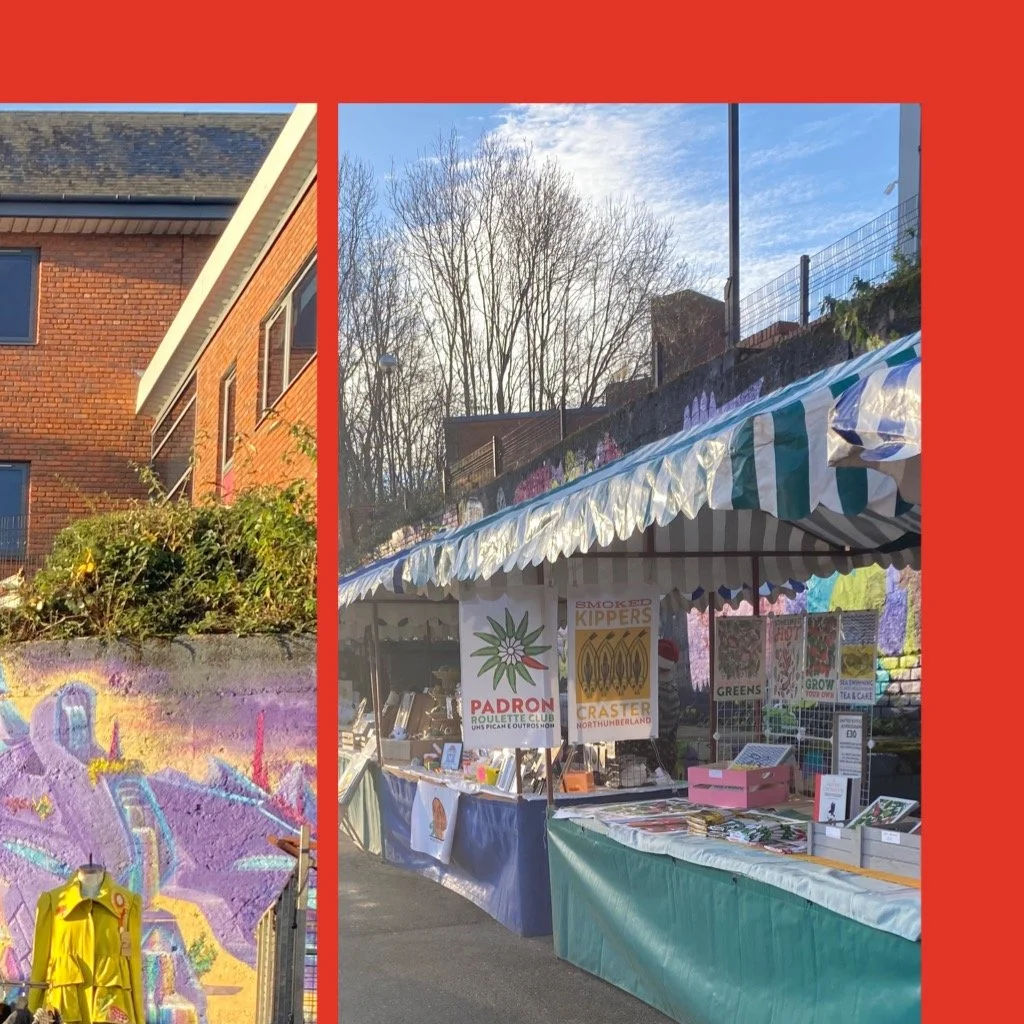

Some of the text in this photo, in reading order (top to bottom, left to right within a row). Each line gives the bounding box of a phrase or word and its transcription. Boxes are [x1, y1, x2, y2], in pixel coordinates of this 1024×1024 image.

[575, 599, 652, 609] SMOKED
[575, 607, 652, 627] KIPPERS
[716, 684, 762, 697] GREENS
[805, 678, 835, 691] GROW
[840, 691, 851, 700] TEA
[857, 691, 872, 700] CAKE
[470, 697, 554, 715] PADRON
[576, 702, 651, 720] CRASTER
[471, 713, 554, 725] ROULETTE CLUB
[576, 717, 652, 729] NORTHUMBERLAND
